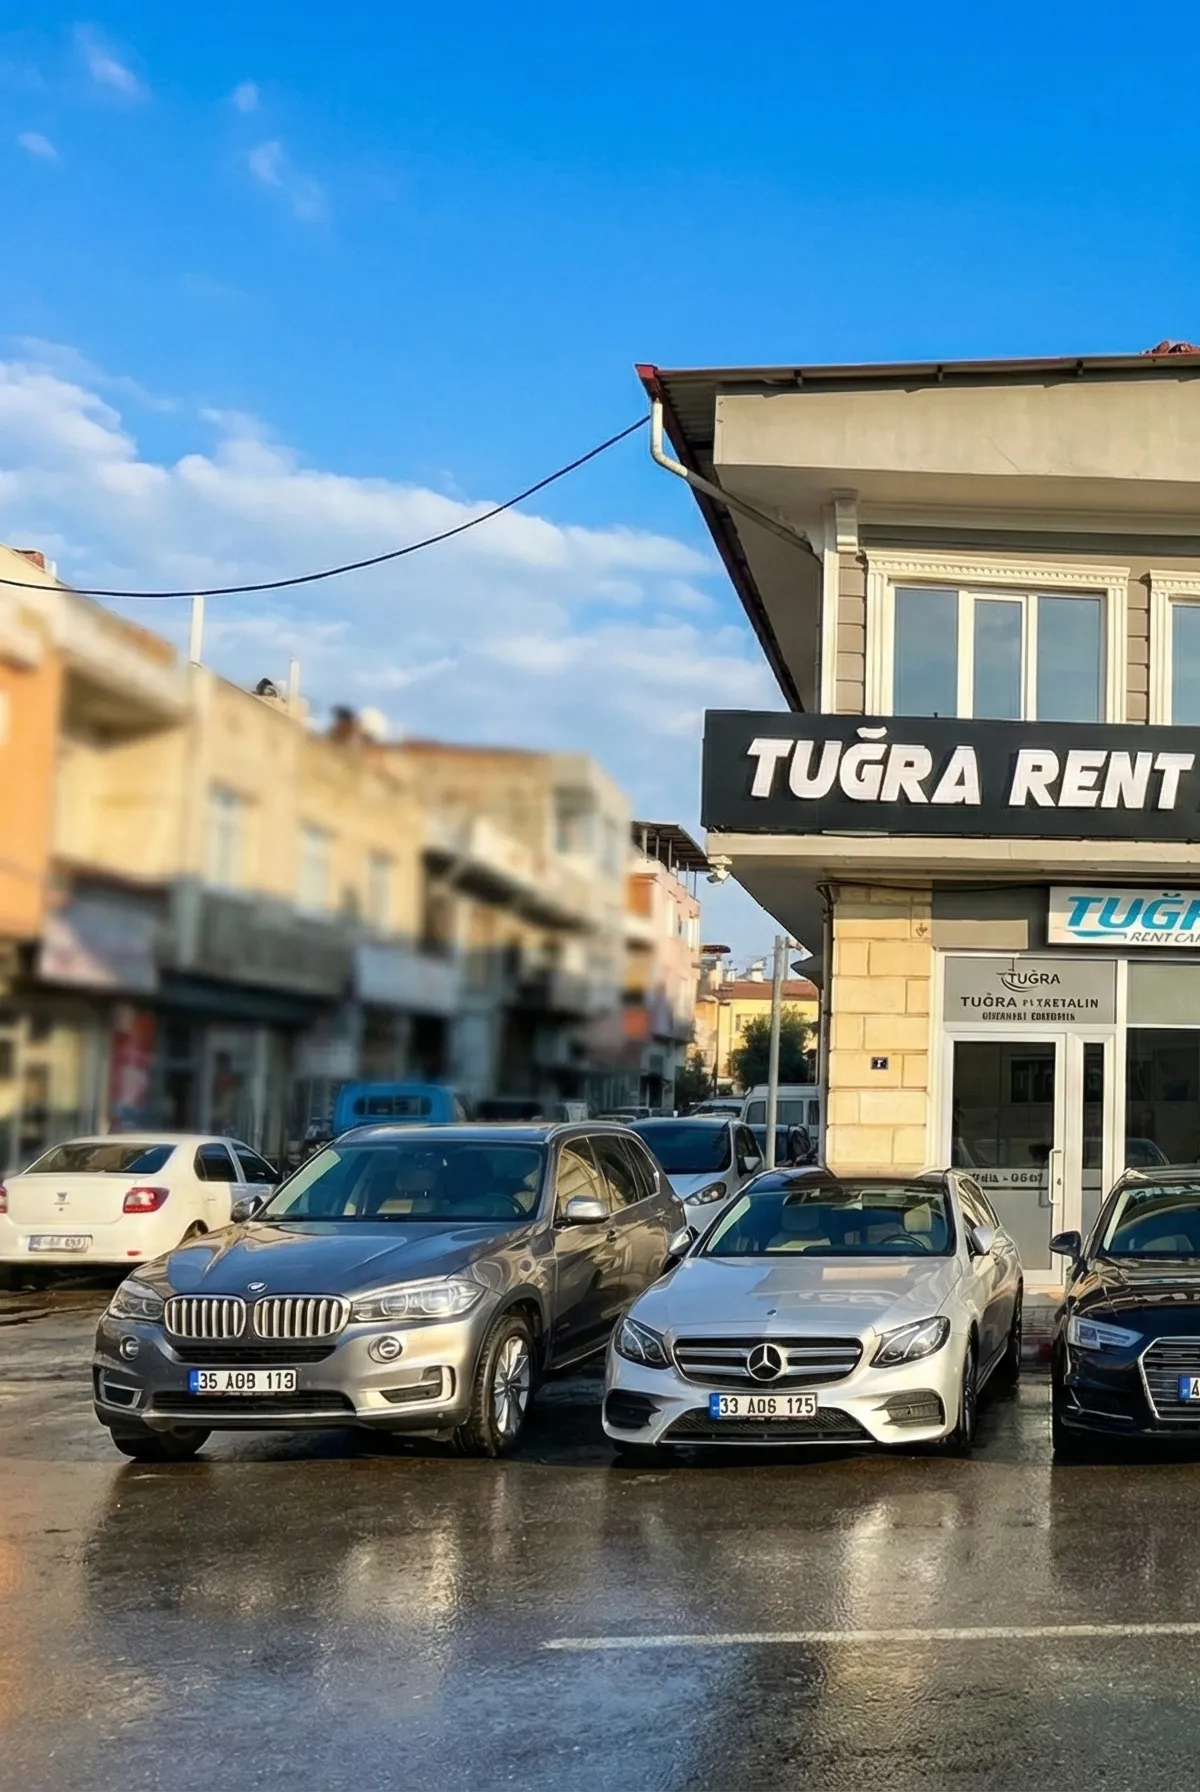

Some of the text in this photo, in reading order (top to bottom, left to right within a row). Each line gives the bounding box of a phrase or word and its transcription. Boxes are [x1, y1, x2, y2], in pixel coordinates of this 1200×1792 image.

[747, 726, 981, 805] TUĞRA
[1008, 749, 1196, 809] RENT
[1129, 931, 1173, 943] RENT
[200, 1372, 218, 1390] 35
[720, 1397, 739, 1414] 33
